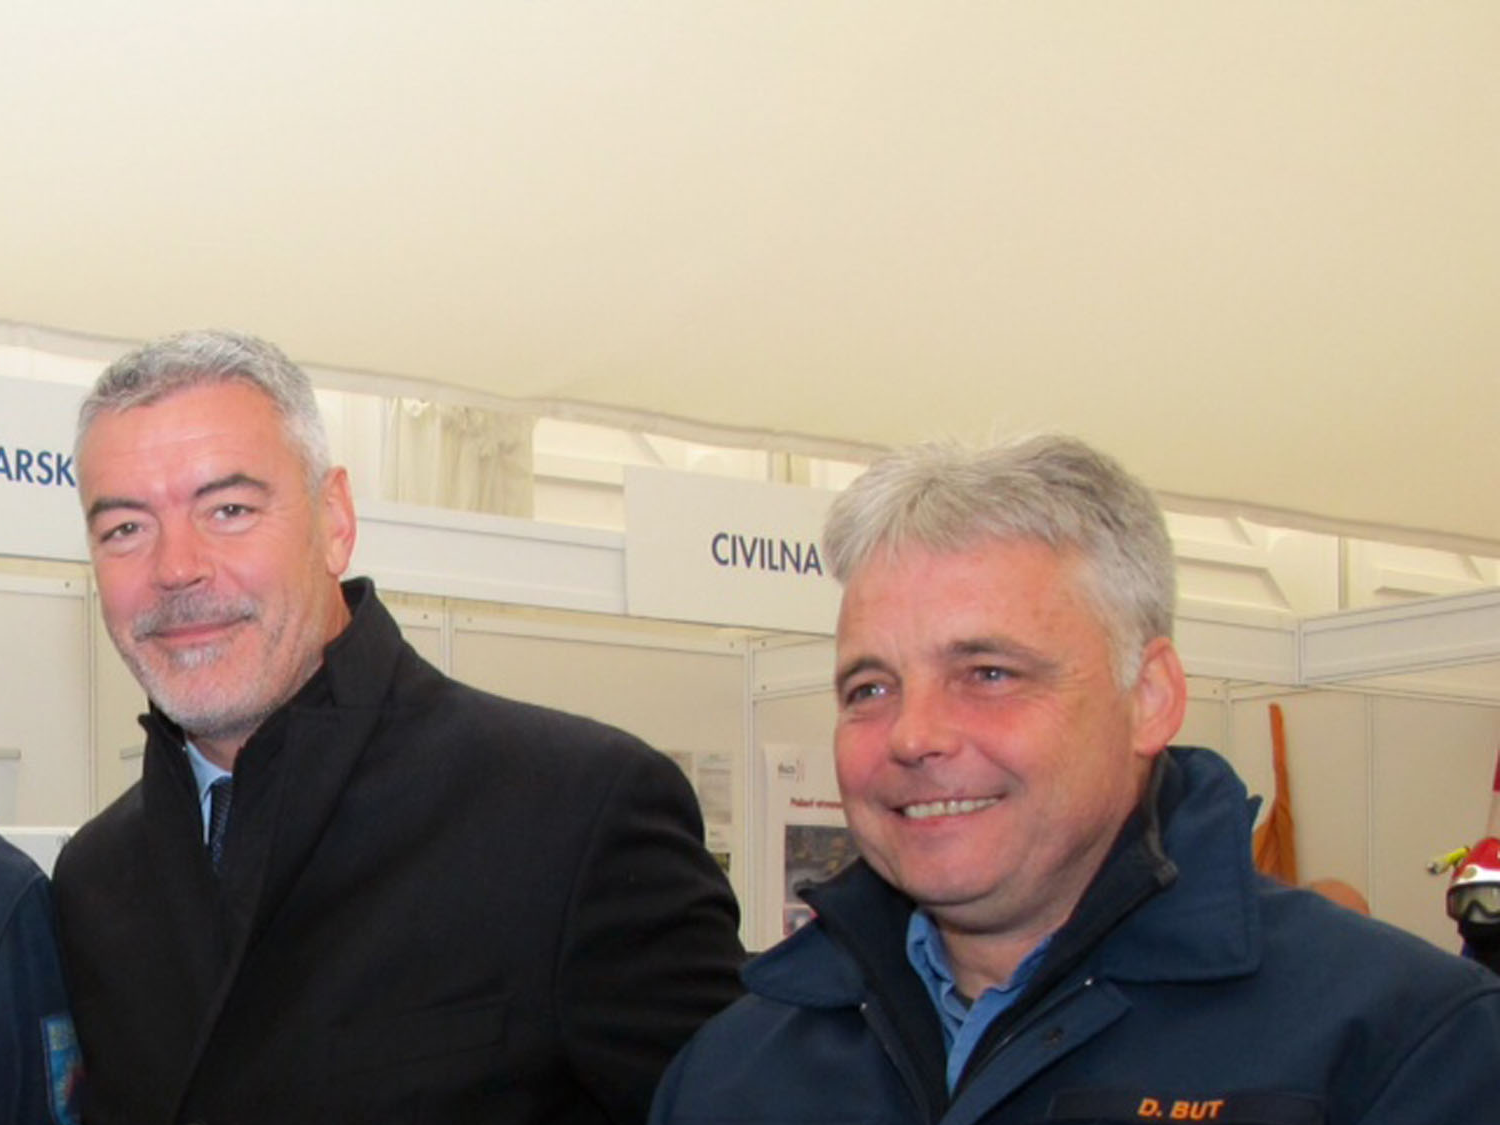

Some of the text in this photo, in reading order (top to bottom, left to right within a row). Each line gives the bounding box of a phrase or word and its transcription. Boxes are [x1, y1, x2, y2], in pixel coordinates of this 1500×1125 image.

[711, 532, 823, 576] CIVILNA
[1137, 1098, 1225, 1120] D. BUT
